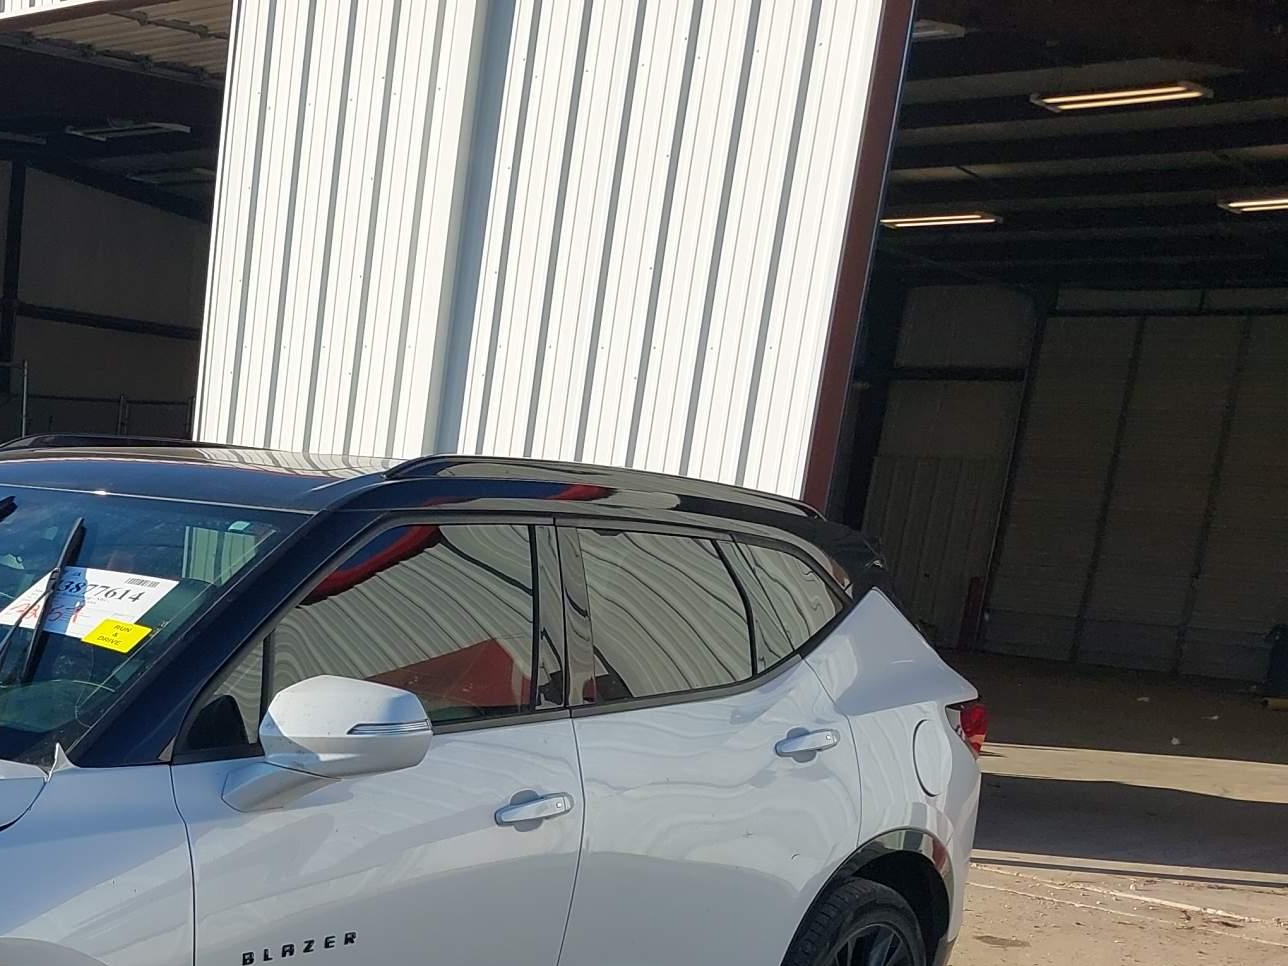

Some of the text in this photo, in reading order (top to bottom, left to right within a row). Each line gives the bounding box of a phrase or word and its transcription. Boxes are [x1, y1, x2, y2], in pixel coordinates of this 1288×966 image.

[113, 624, 133, 634] RUN
[97, 635, 123, 646] DRIVE
[241, 931, 358, 966] BLAZER
